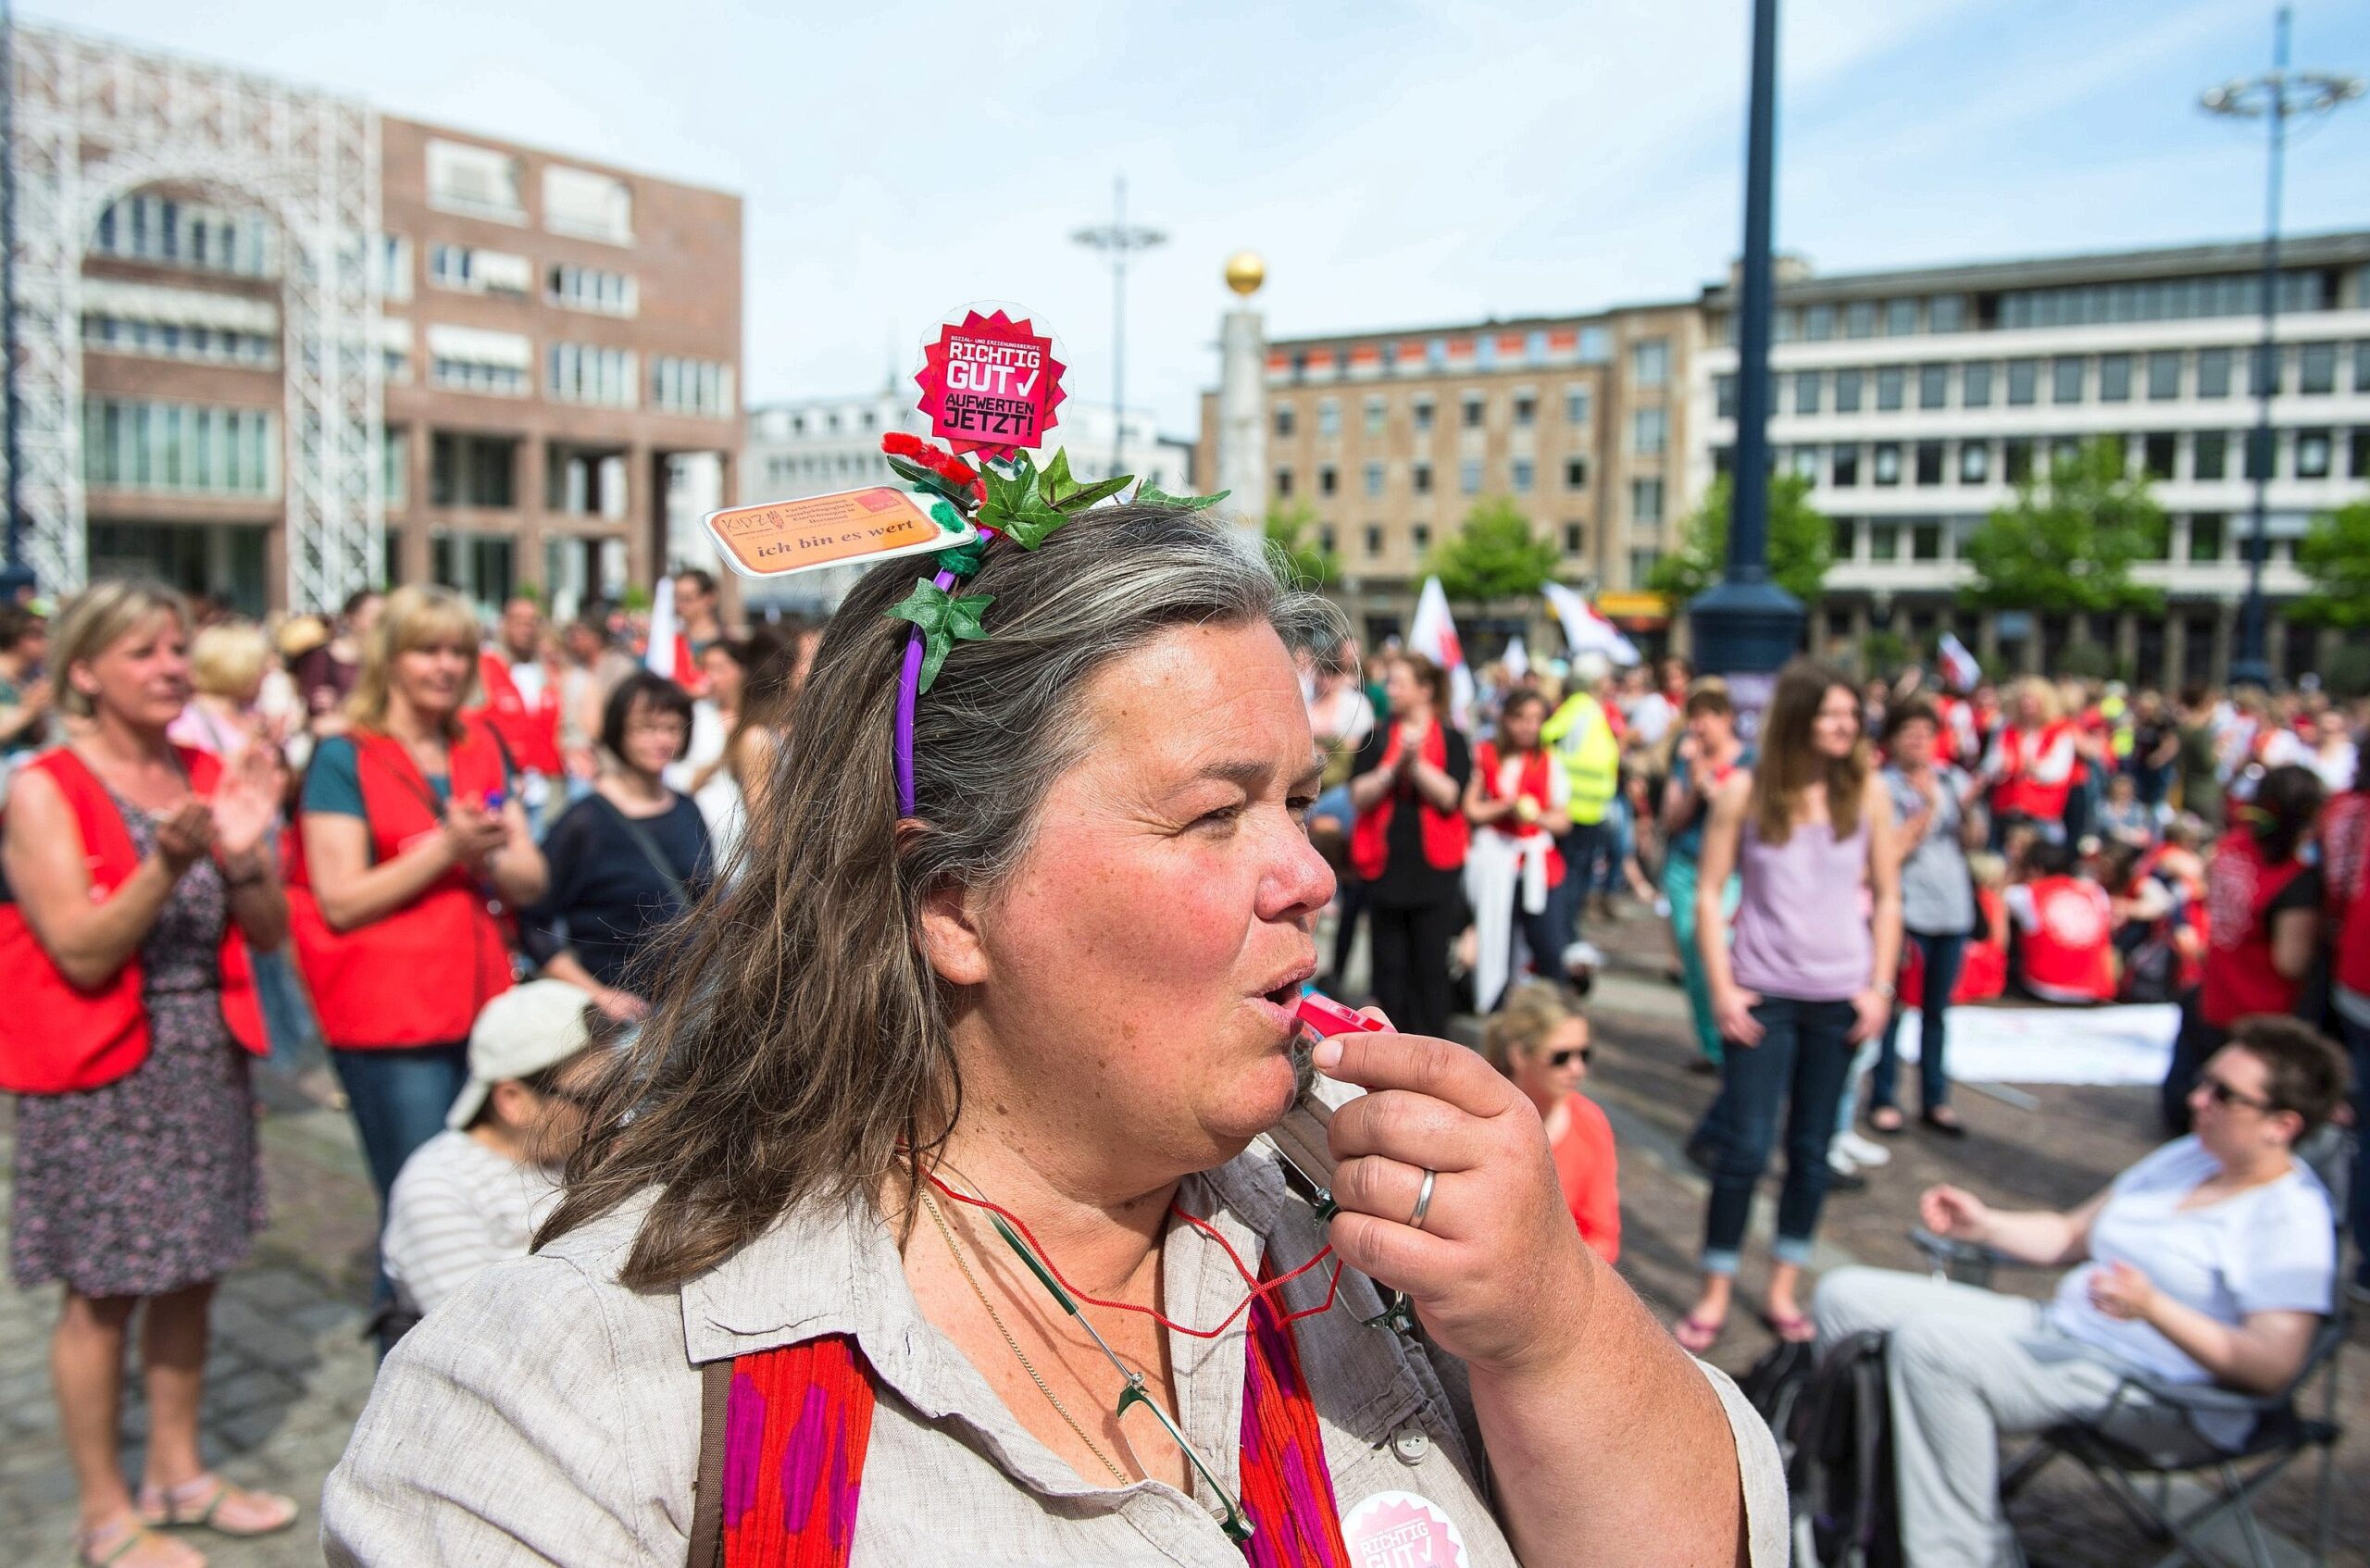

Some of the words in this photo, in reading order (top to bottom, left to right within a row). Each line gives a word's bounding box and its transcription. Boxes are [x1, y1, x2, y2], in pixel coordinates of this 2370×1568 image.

[949, 342, 1041, 368] RICHTIG
[946, 359, 1016, 394] GUT
[945, 392, 1035, 416] AUFWERTEN
[943, 406, 1034, 437] JETZT!
[757, 541, 792, 557] ich
[799, 535, 834, 549] bin
[842, 531, 862, 541] es
[868, 519, 914, 537] wert
[1360, 1522, 1428, 1557] RICHTIG
